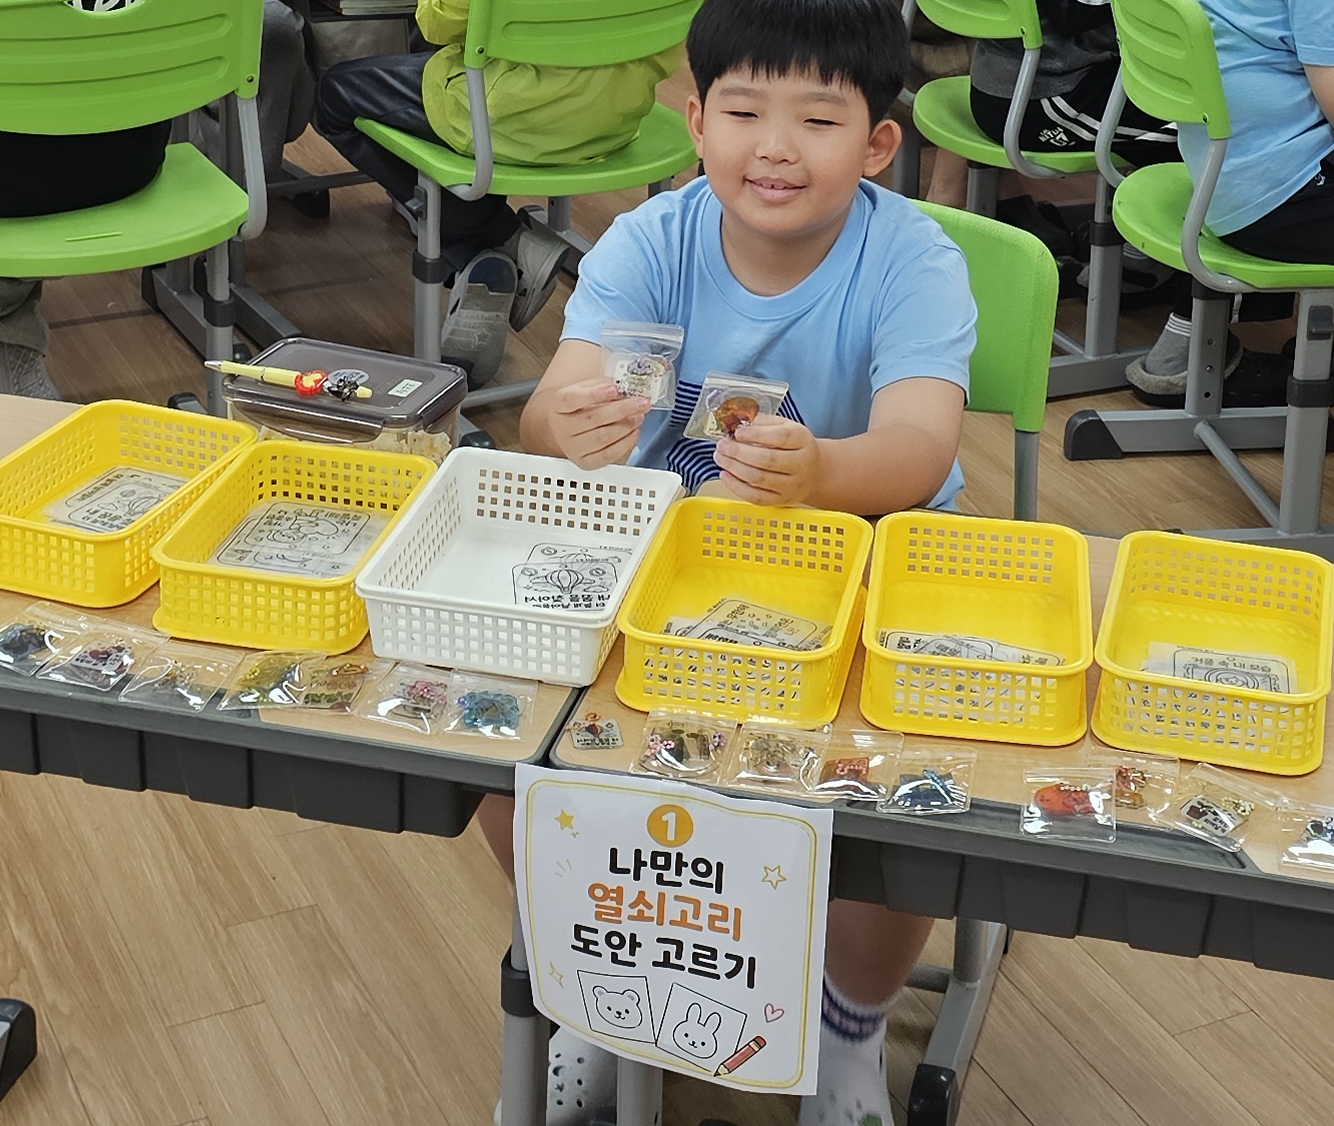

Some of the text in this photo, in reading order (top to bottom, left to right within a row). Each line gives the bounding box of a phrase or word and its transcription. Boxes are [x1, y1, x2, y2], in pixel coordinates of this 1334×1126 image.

[661, 811, 679, 841] 1
[609, 847, 724, 894] 나만의
[587, 883, 742, 942] 열쇠고리
[570, 923, 757, 990] 도안 고르기
